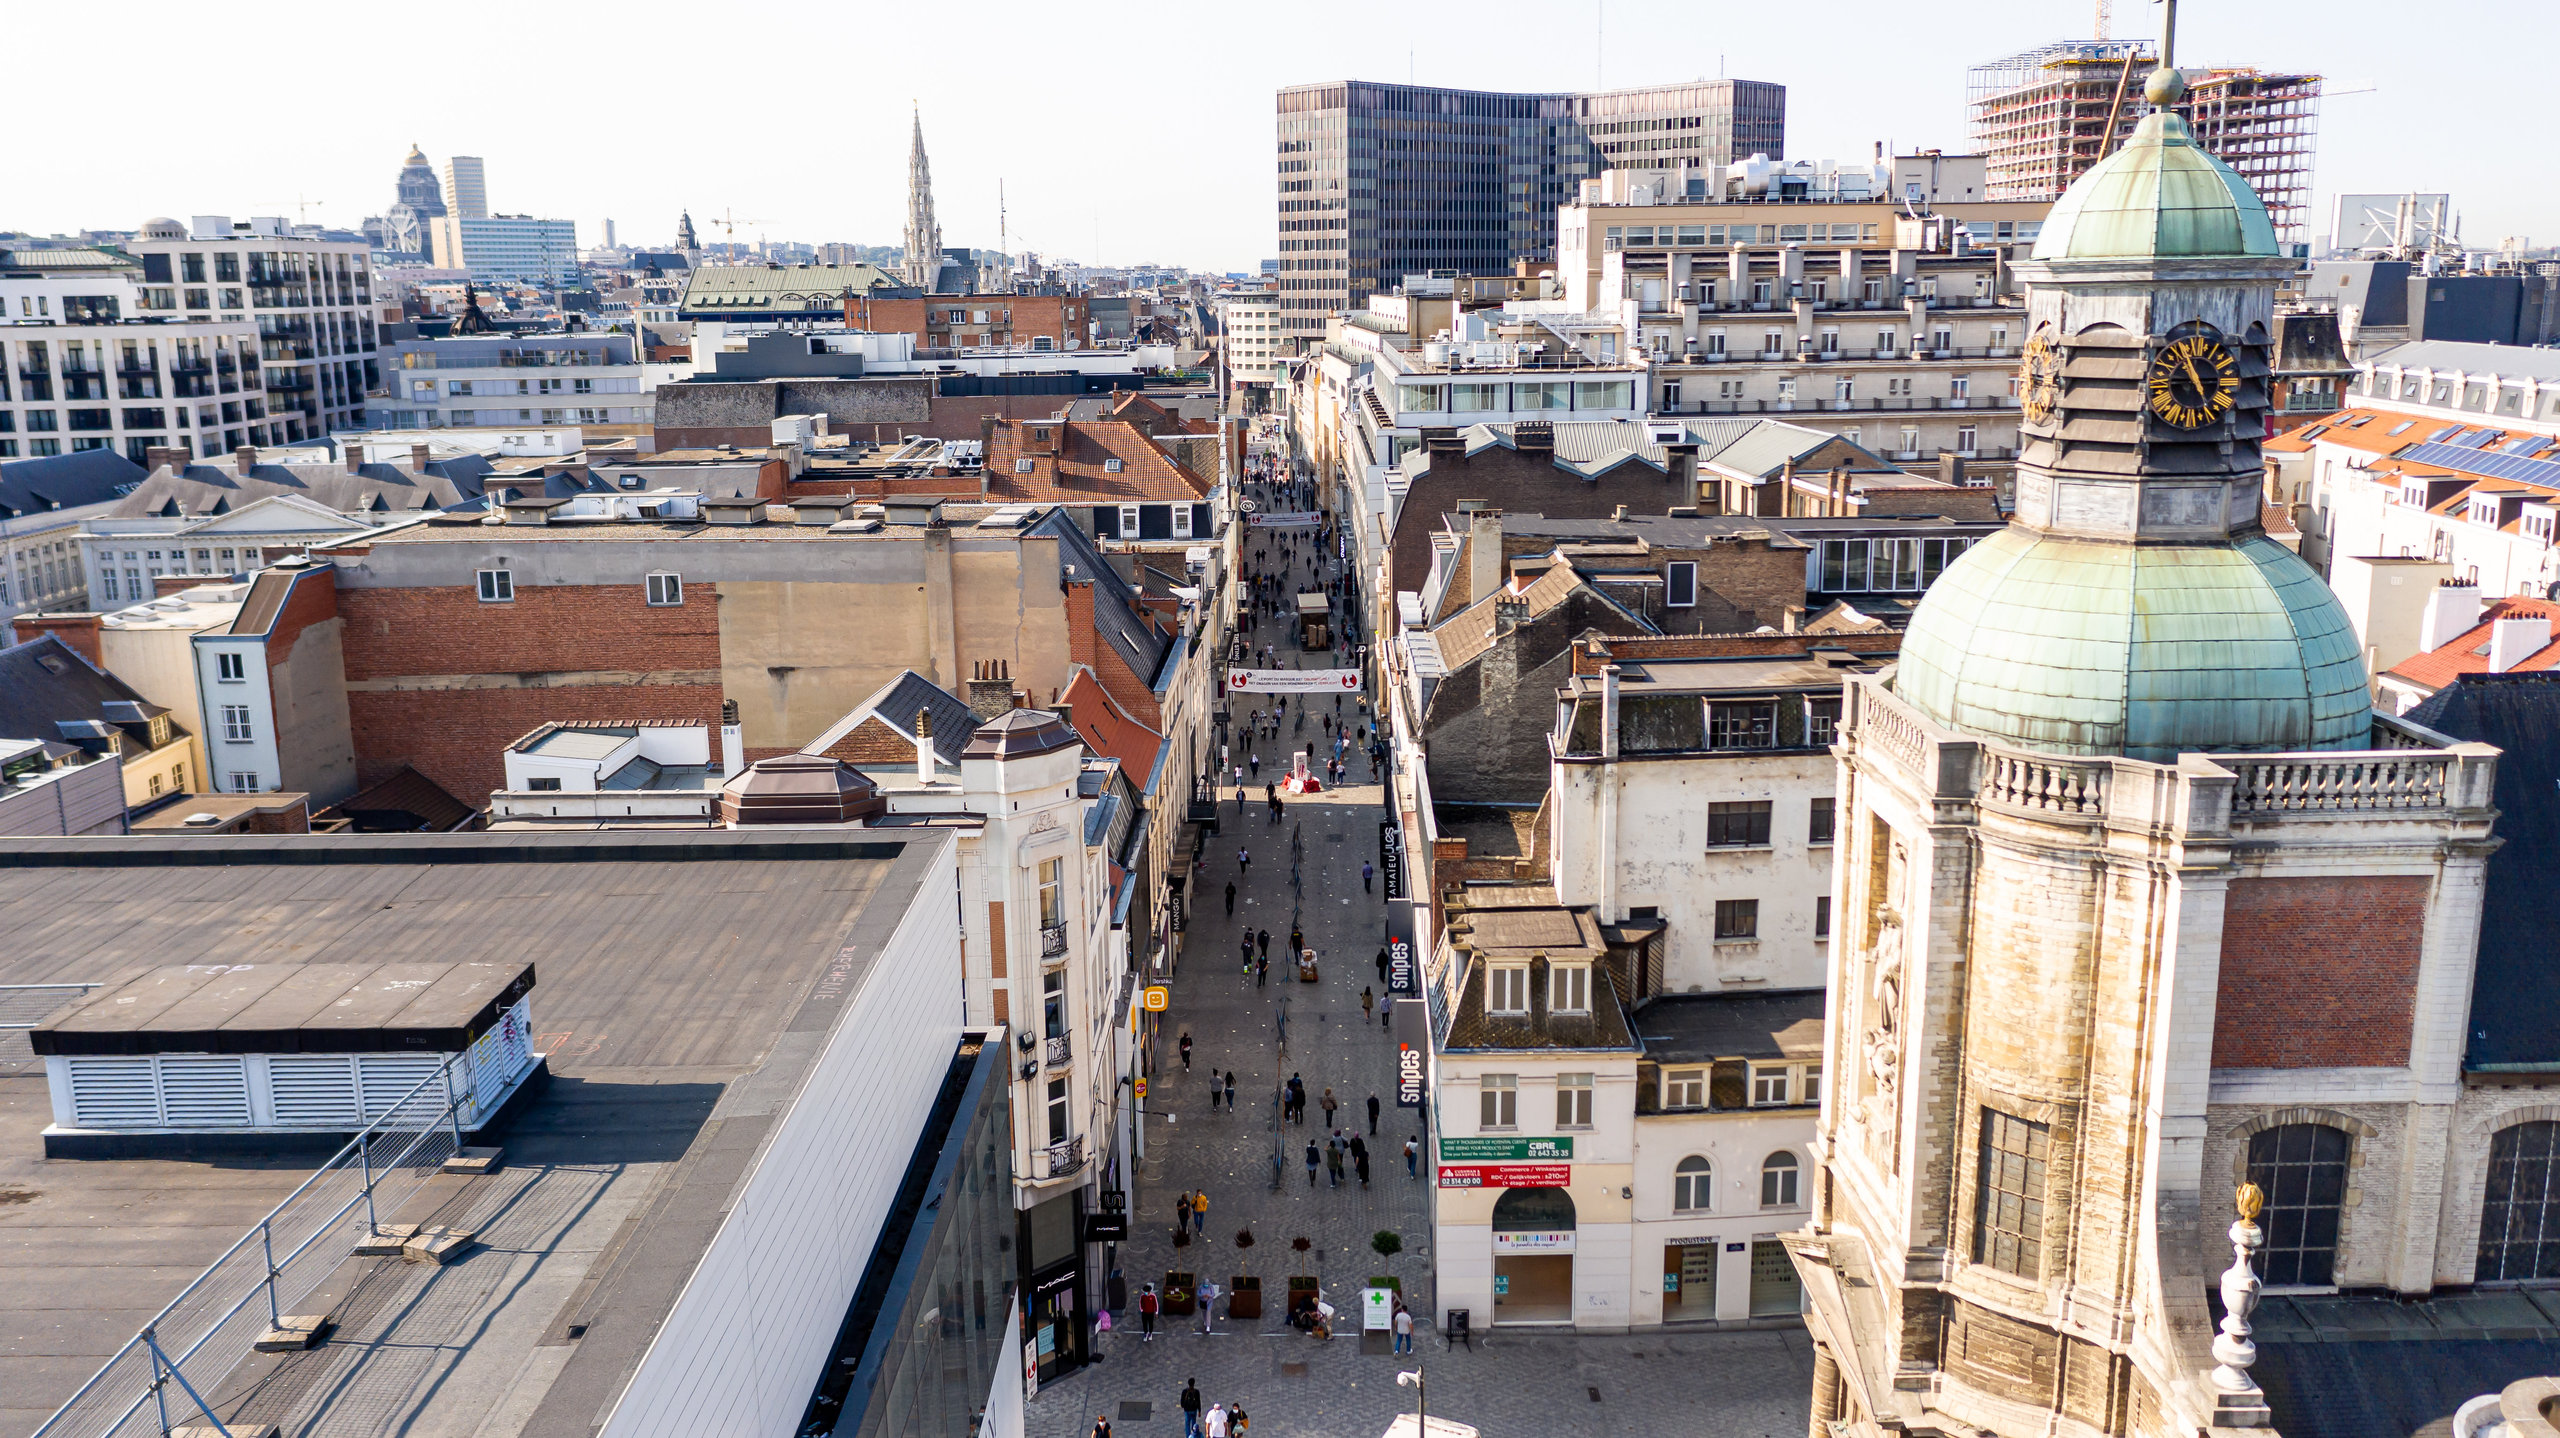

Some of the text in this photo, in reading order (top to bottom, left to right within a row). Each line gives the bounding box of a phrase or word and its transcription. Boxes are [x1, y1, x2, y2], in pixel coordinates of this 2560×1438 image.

[1387, 854, 1396, 899] AMAÏEU
[1392, 942, 1411, 989] snipes
[1401, 1050, 1422, 1103] snipes
